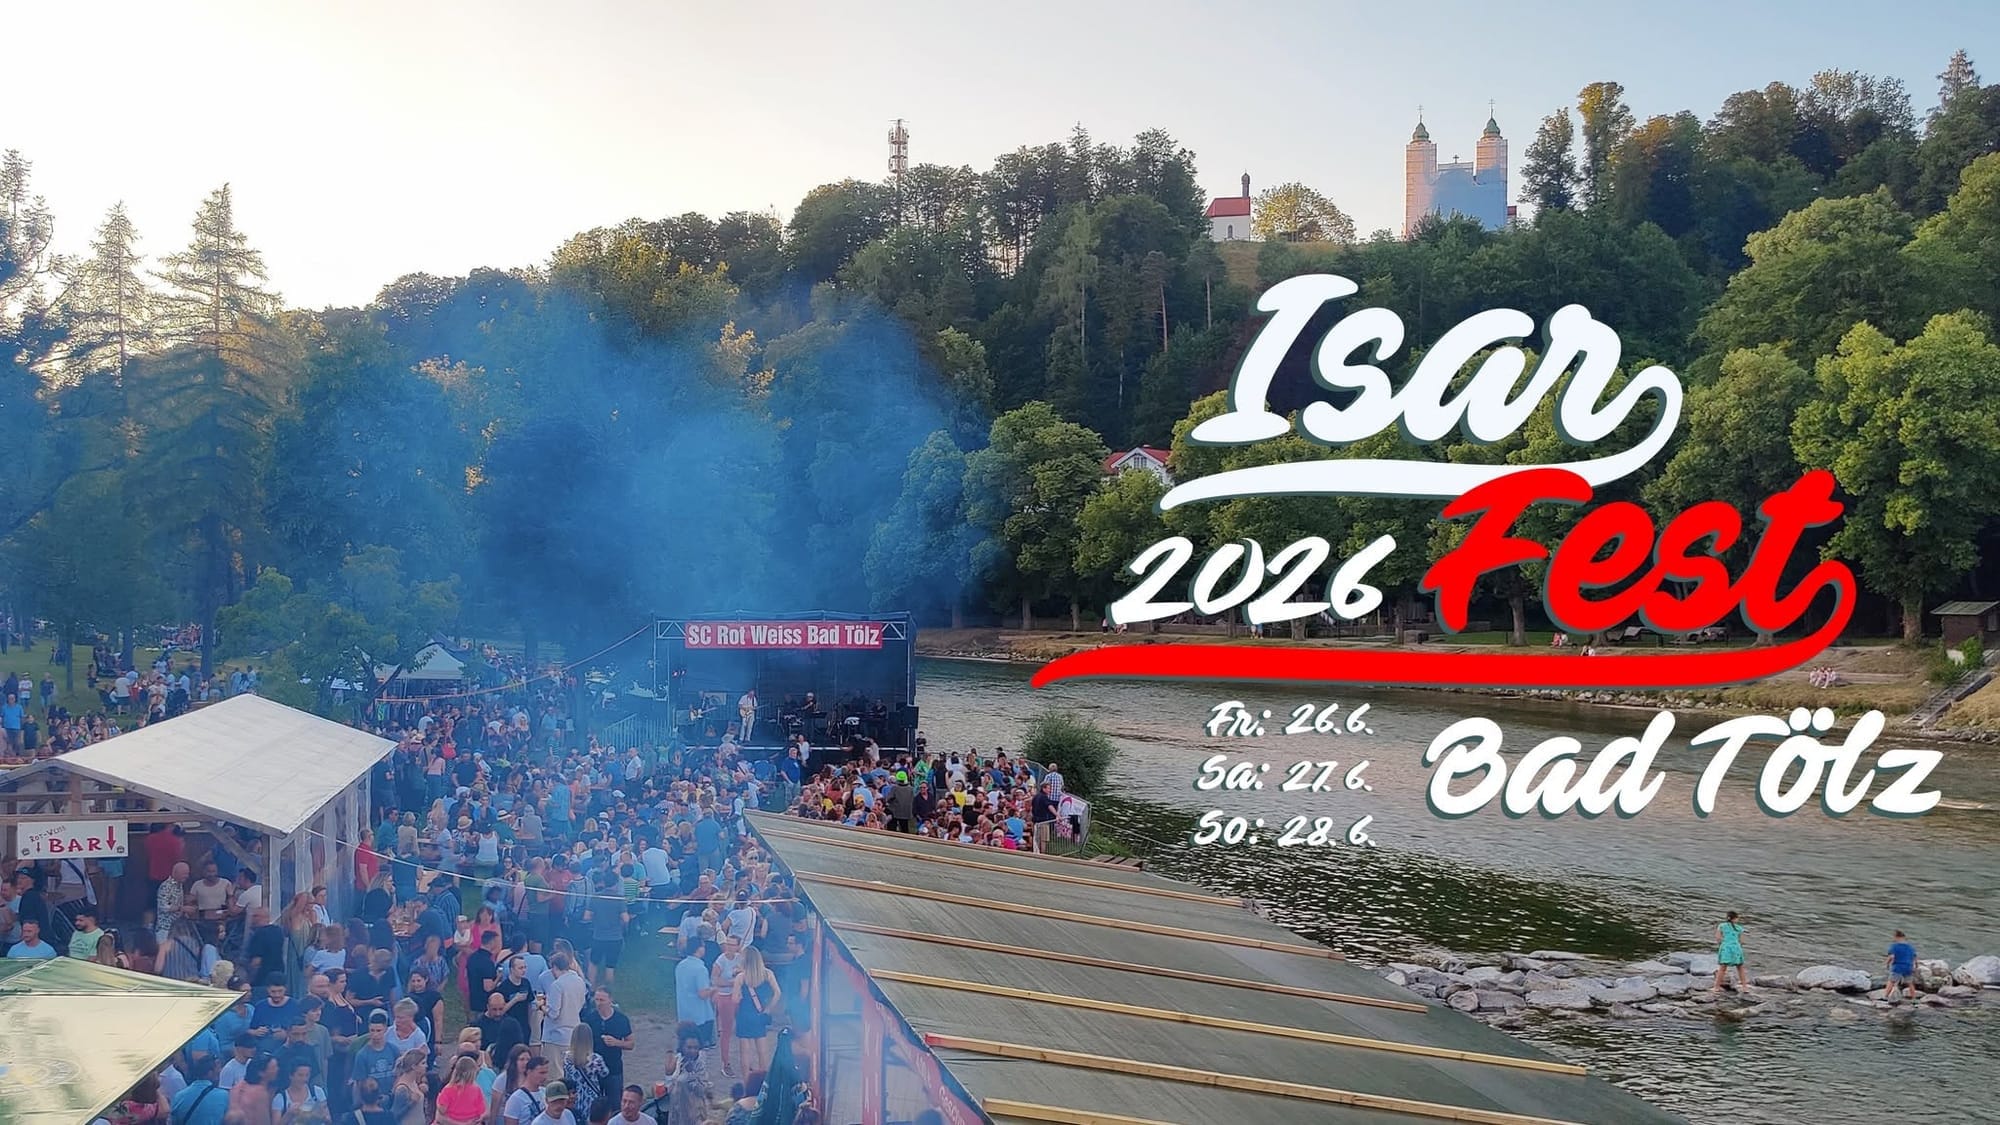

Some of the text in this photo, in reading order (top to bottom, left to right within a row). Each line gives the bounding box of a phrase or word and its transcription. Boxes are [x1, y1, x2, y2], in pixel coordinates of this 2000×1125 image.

[687, 624, 880, 646] SC Rot Weiss Bad Tölz
[48, 837, 102, 853] BAR
